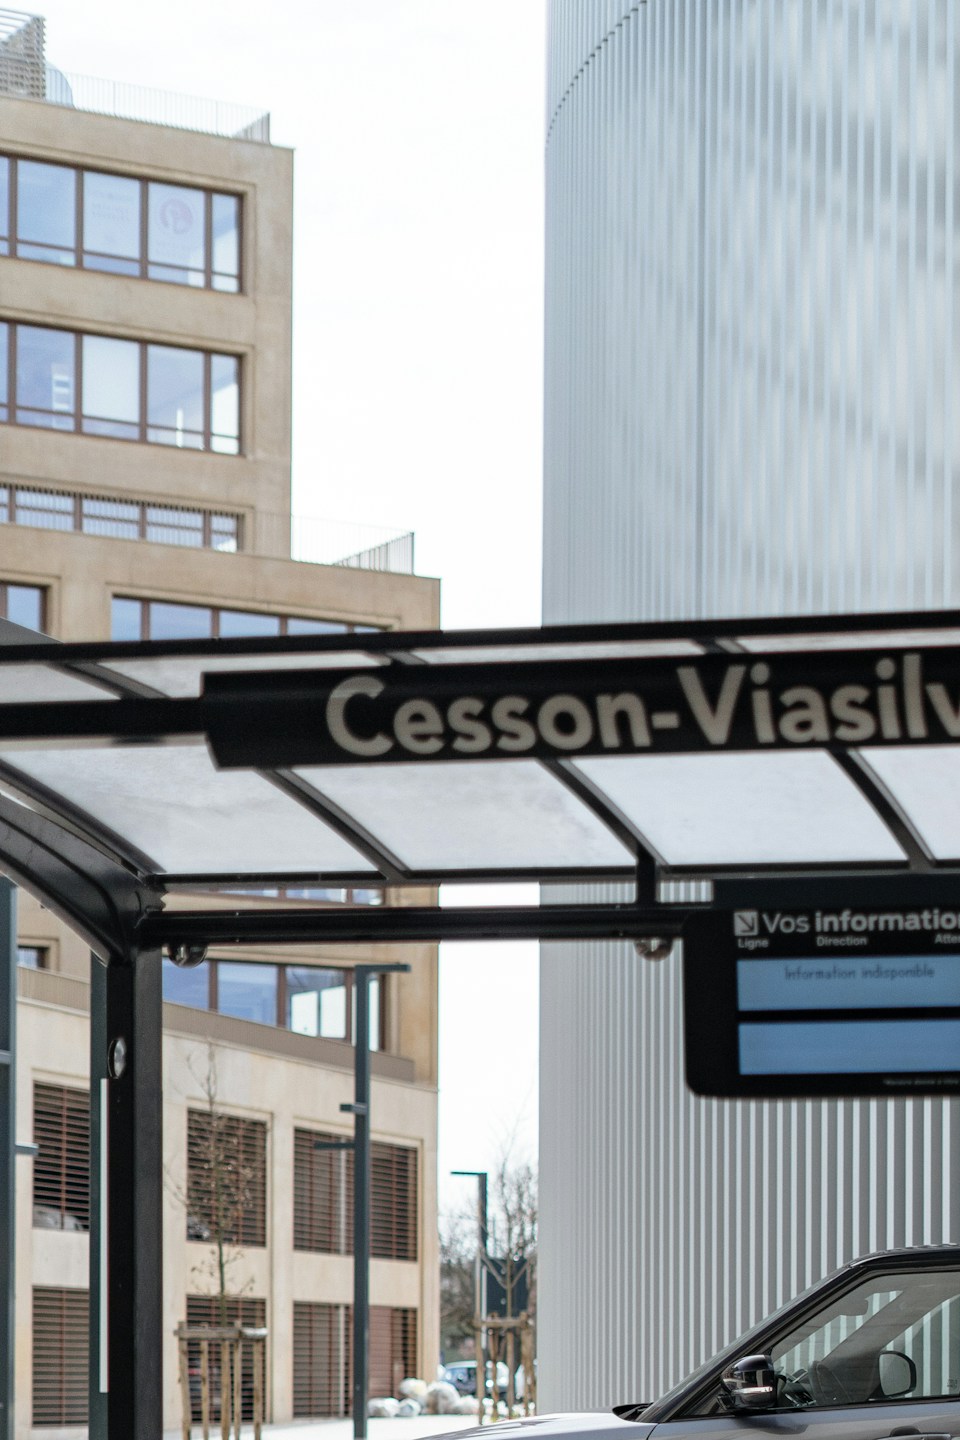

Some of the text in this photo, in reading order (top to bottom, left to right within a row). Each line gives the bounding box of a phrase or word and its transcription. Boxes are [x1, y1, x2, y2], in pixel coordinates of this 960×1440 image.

[762, 912, 810, 933] Vos
[738, 938, 769, 950] Ligne
[816, 935, 868, 947] Direction
